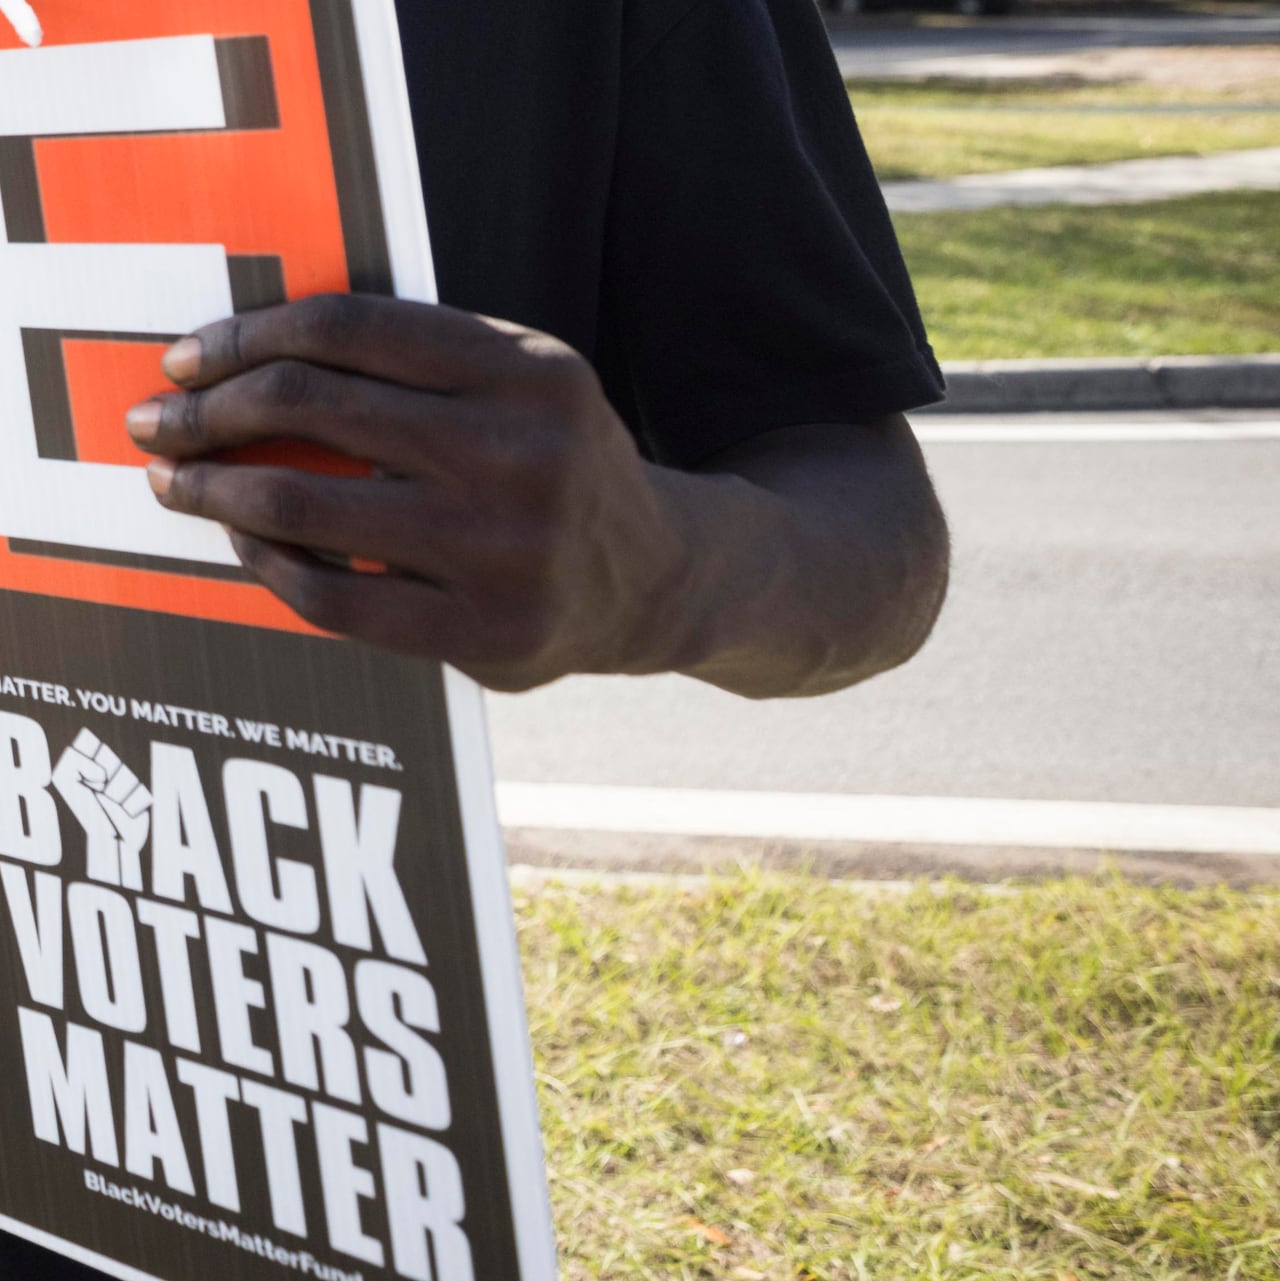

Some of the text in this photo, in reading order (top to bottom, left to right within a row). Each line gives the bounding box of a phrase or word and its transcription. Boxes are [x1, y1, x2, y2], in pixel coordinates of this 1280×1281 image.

[76, 688, 127, 717] YOU
[130, 698, 236, 738] MATTER.
[236, 718, 282, 747] WE
[285, 727, 404, 771] MATTER.
[17, 1005, 475, 1281] MATTER
